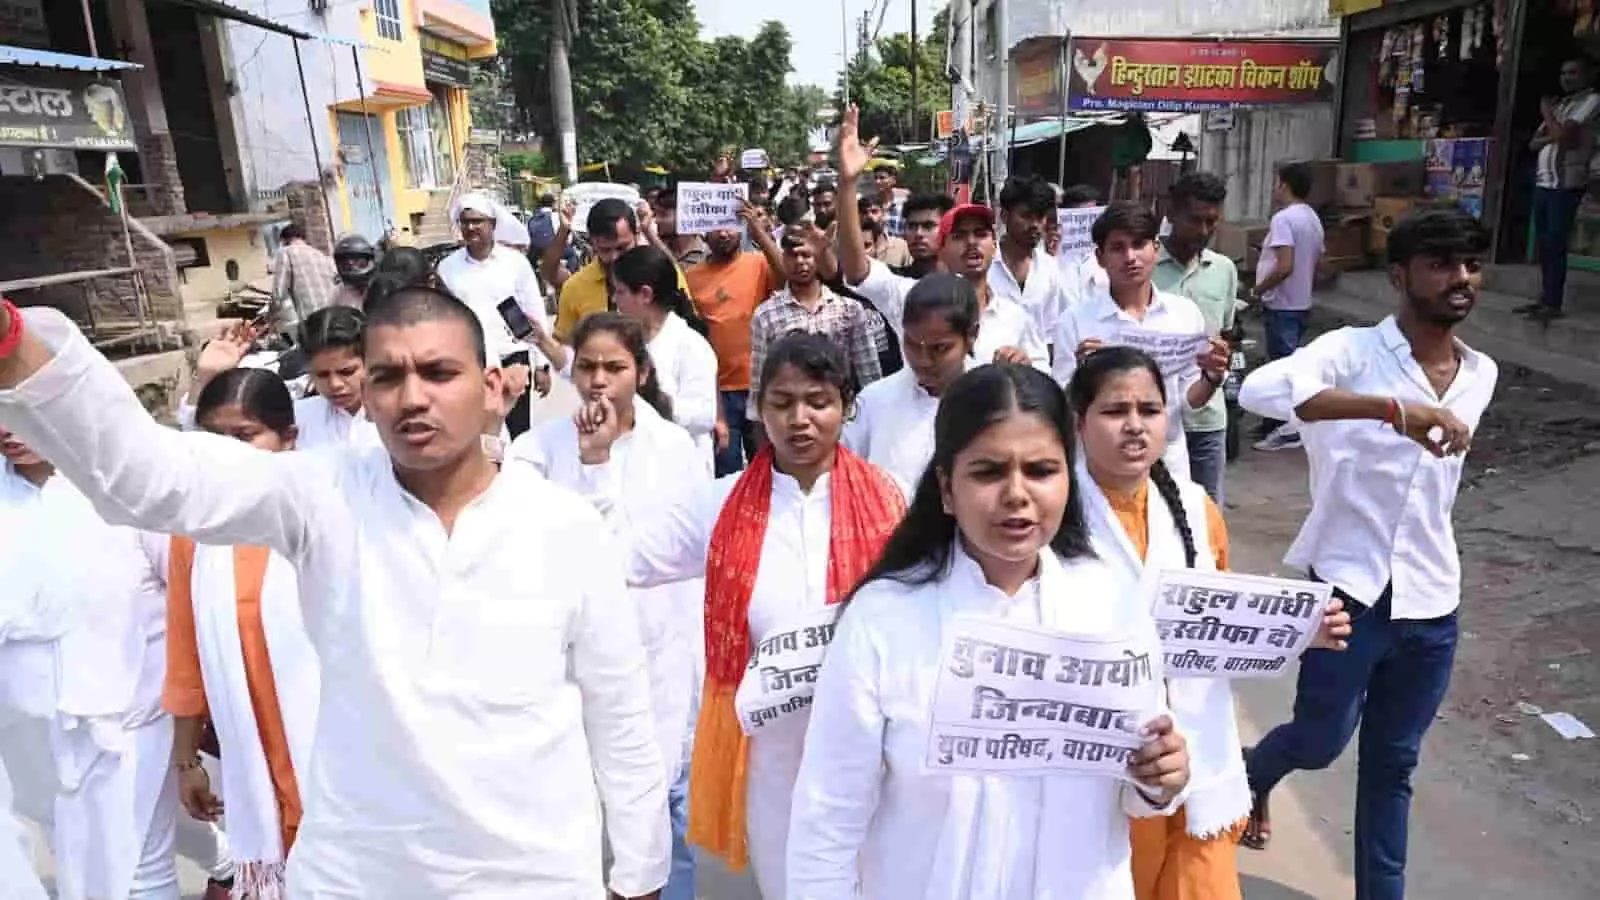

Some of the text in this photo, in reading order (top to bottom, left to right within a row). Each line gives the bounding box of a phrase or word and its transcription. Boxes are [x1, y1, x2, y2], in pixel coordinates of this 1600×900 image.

[1112, 56, 1181, 94] हिन्दुस्तान
[1240, 59, 1286, 88] चिकन
[1289, 58, 1323, 89] शॉप
[1161, 583, 1319, 619] राहुल गांधी
[1265, 624, 1304, 649] दो
[1172, 649, 1219, 672] परिषद,
[1224, 656, 1286, 672] वाराणसी
[938, 735, 982, 765] युवा
[985, 733, 1053, 762] परिषद,
